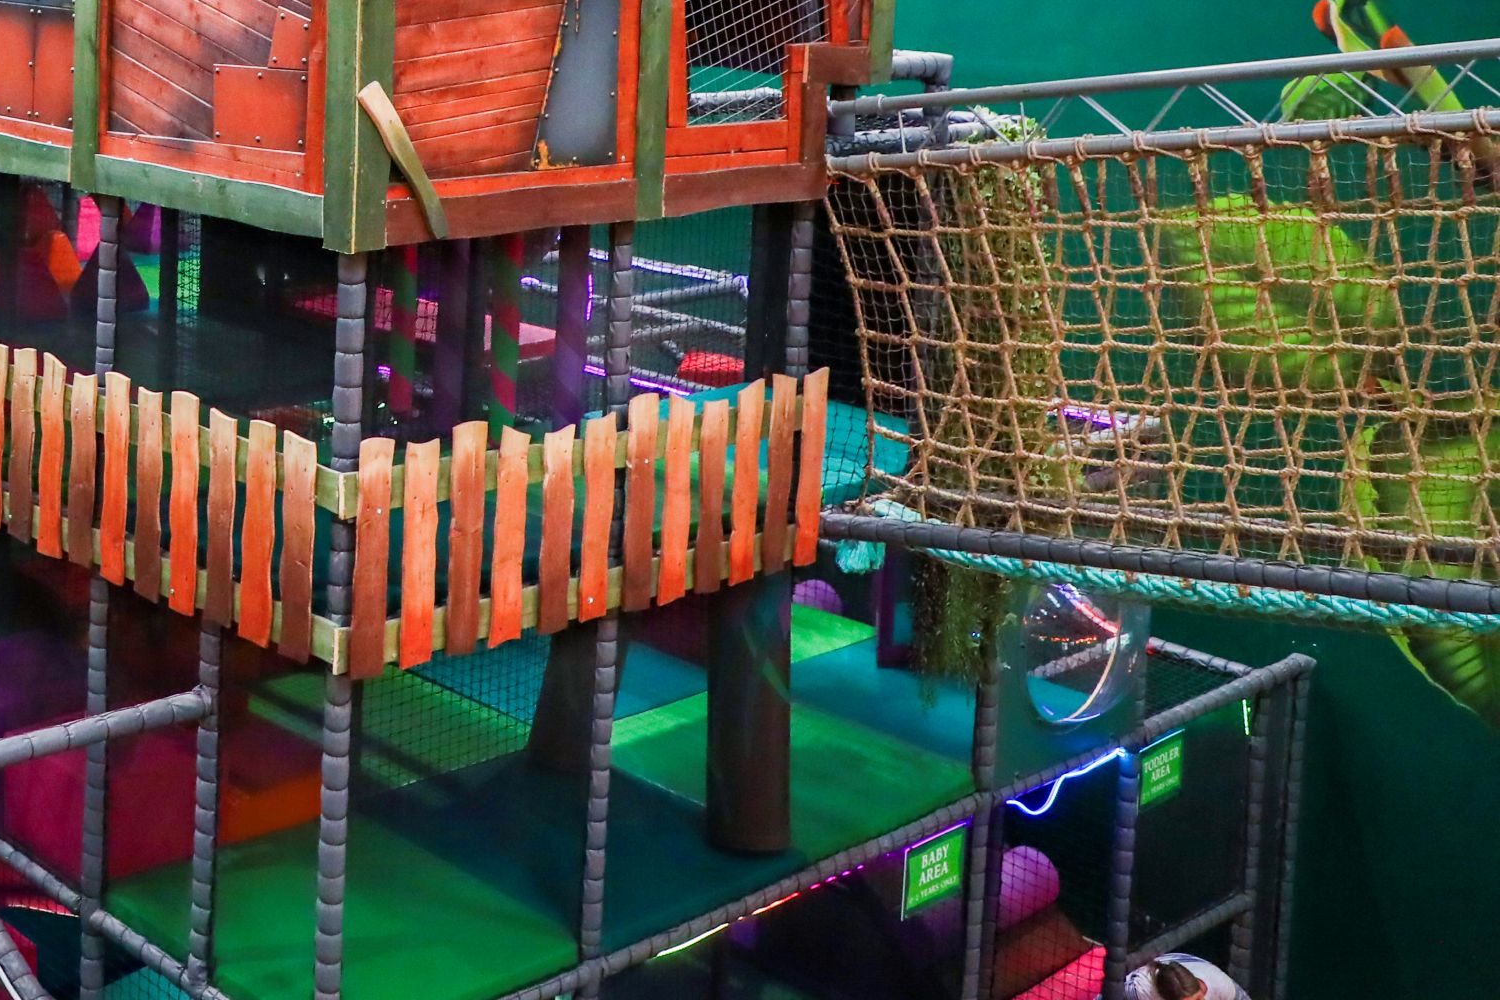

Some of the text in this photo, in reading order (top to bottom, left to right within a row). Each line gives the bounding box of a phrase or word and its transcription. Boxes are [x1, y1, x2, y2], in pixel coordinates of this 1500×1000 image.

[1144, 746, 1180, 773] TODDLER
[1150, 764, 1171, 783] AREA
[921, 843, 950, 869] BABY
[918, 861, 949, 887] AREA
[920, 884, 940, 898] YEARS
